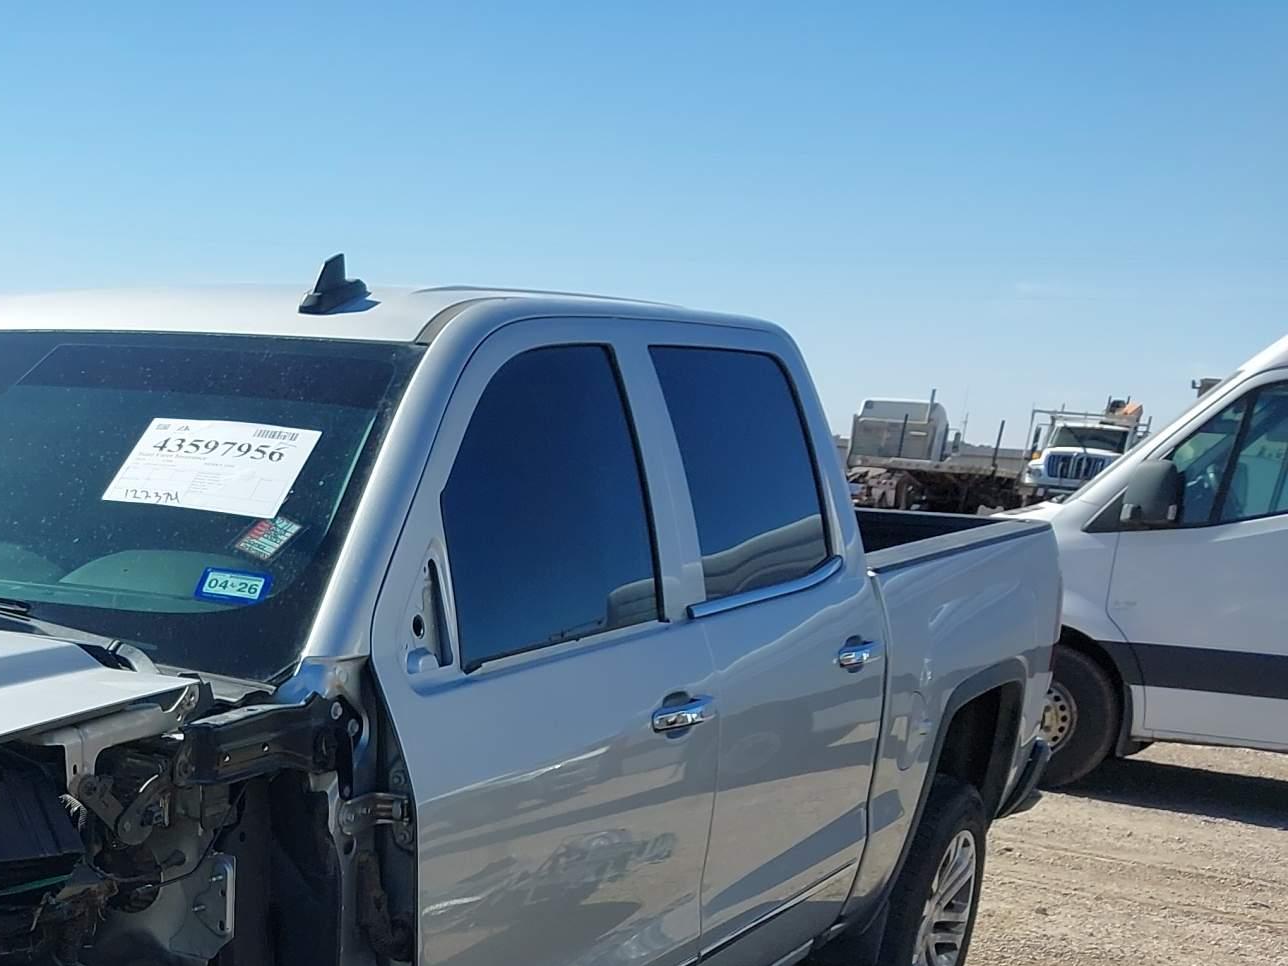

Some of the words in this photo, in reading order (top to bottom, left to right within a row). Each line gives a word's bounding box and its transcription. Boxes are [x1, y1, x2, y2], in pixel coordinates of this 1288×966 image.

[152, 437, 285, 464] 43597956
[207, 577, 230, 591] 04
[236, 581, 260, 595] 26
